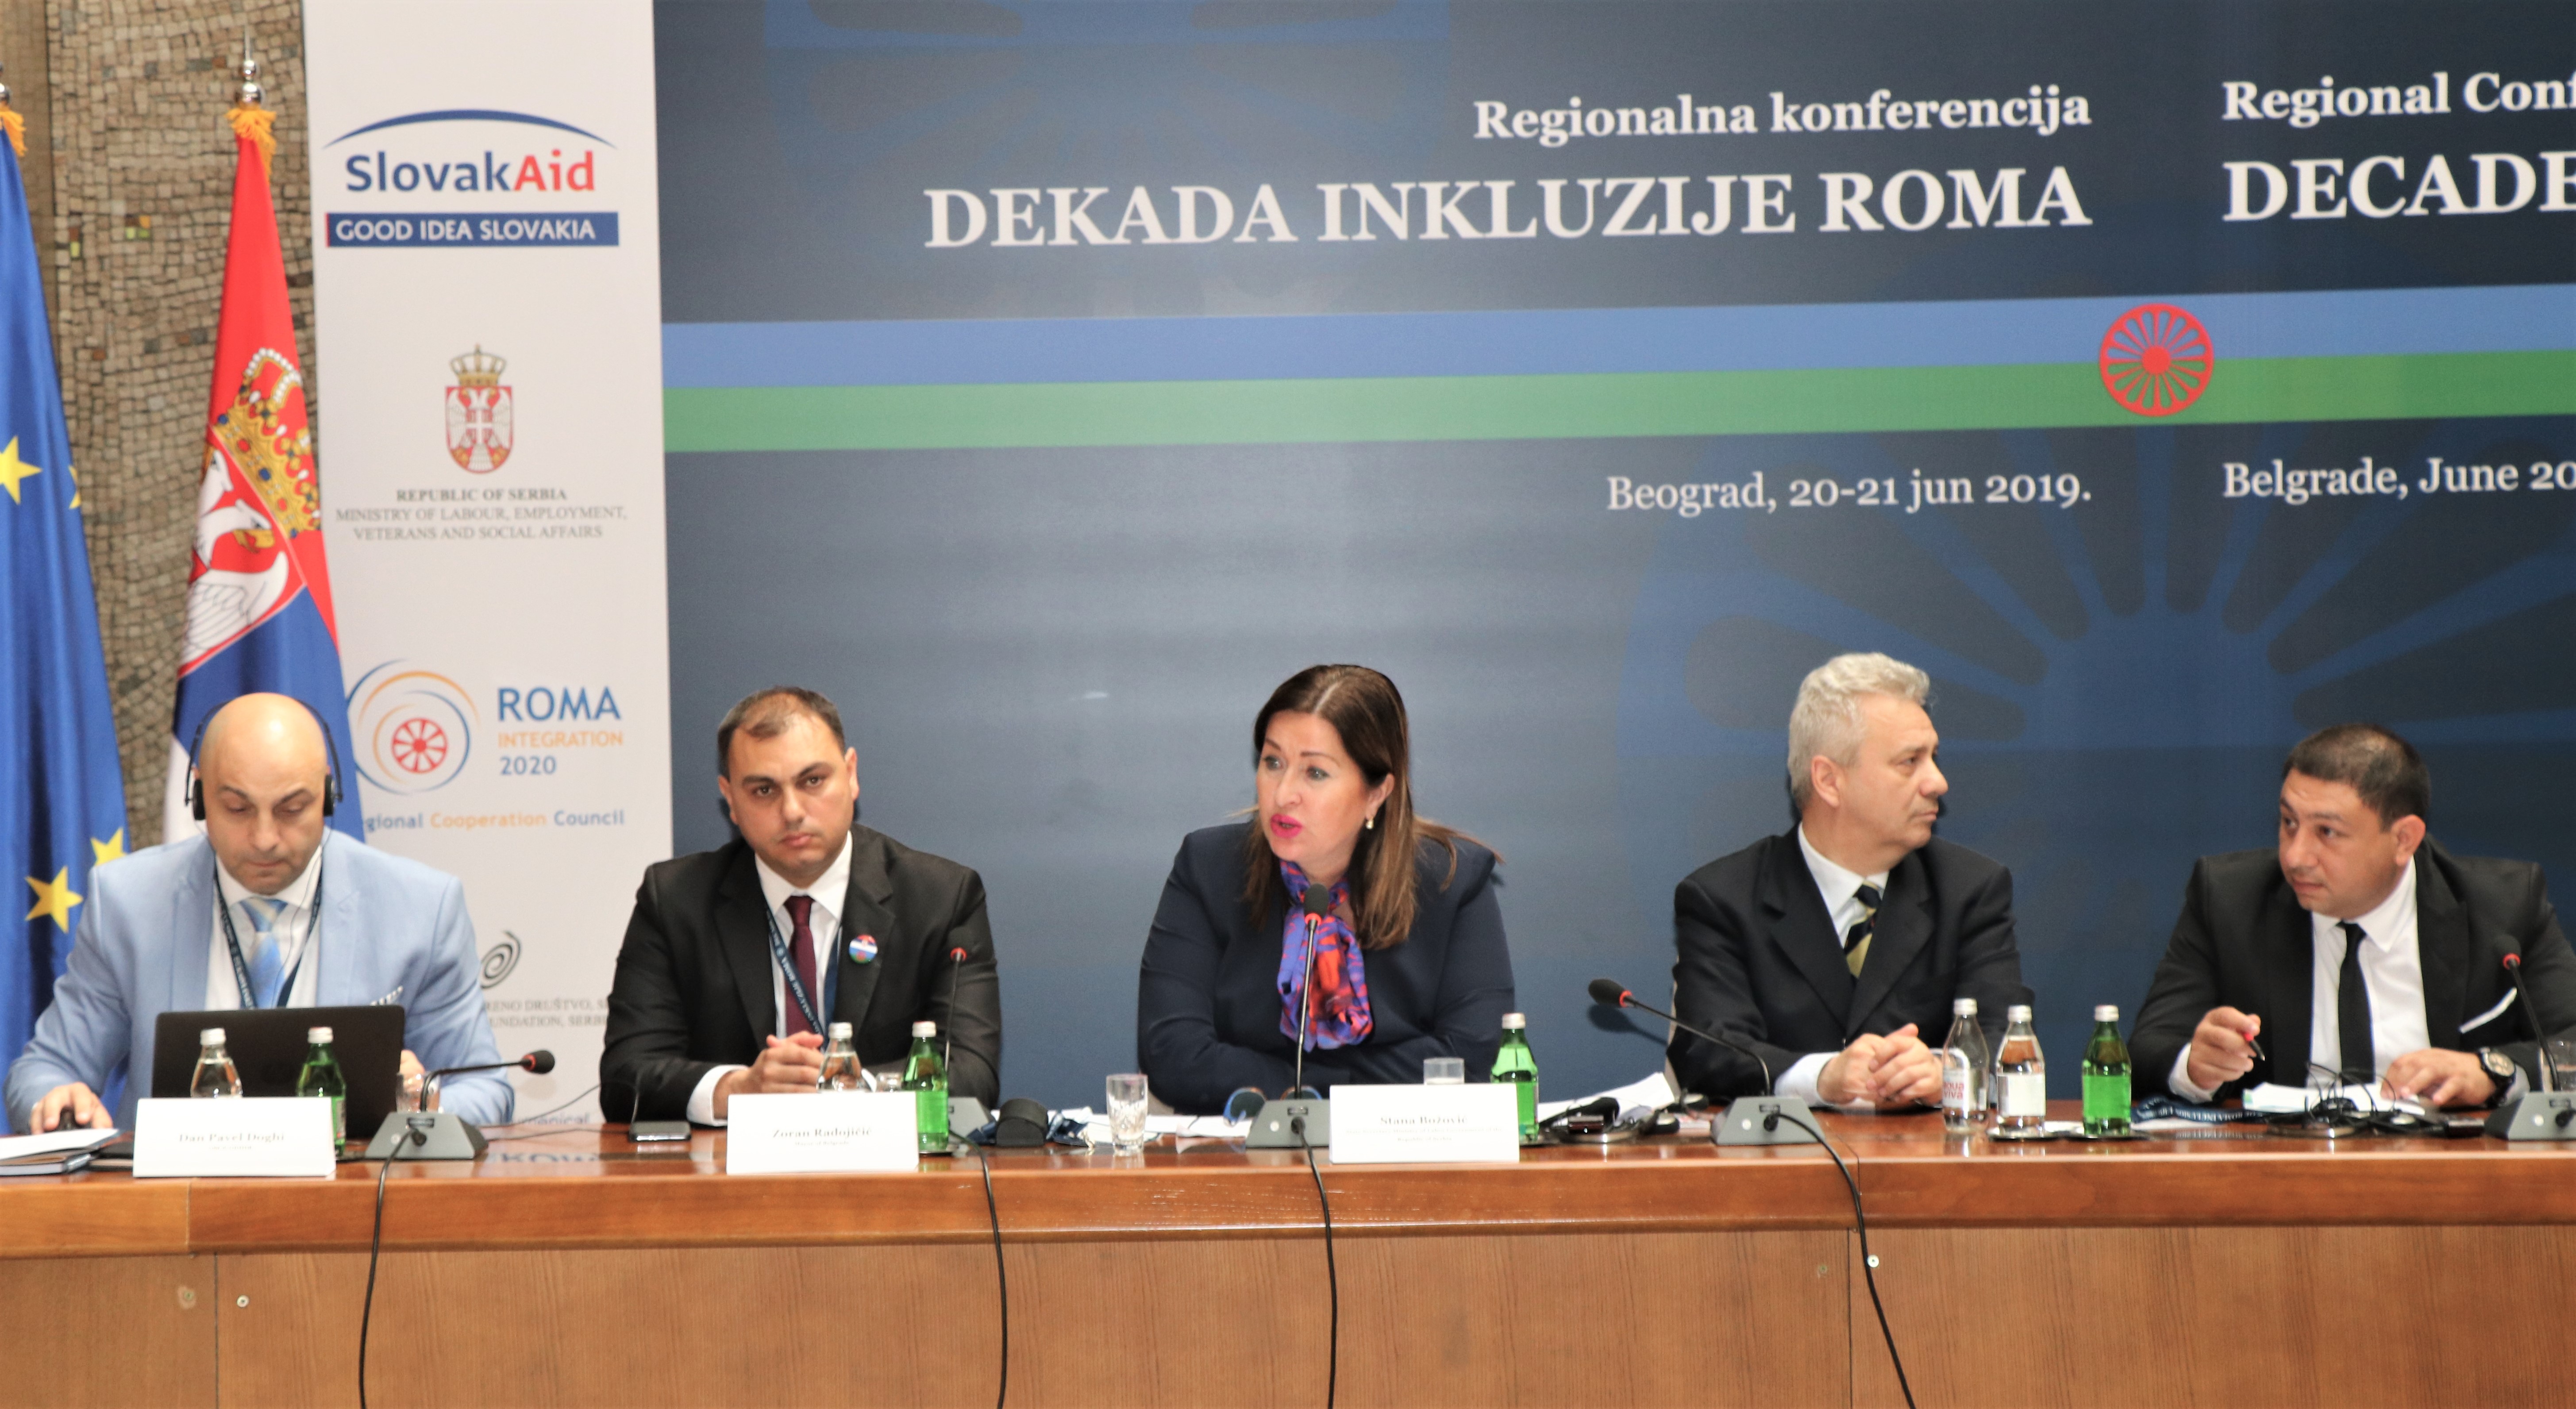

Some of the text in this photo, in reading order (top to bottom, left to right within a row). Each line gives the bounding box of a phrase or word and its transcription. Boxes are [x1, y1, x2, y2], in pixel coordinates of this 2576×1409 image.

[2222, 71, 2451, 128] Regional
[1473, 84, 2092, 148] Regionalna konferencija
[345, 149, 594, 192] SlovakAid
[2222, 150, 2576, 221] DECADE
[924, 166, 2093, 248] DEKADA INKLUZIJE ROMA
[335, 219, 596, 241] GOOD IDEA SLOVAKIA
[2223, 456, 2576, 505] Belgrade, June 20
[396, 488, 567, 502] REPUBLIC OF SERBIA
[1607, 469, 2091, 518] Beograd, 20-21 jun 2019.
[335, 505, 628, 522] MINISTRY OF LABOUR, EMPLOYMENT,
[353, 525, 603, 541] VETERANS AND SOCIAL AFFAIRS
[498, 686, 621, 722] ROMA
[498, 731, 624, 749] INTEGRATION
[500, 755, 557, 776] 2020
[365, 809, 625, 833] gional Cooperation Council
[485, 1000, 522, 1011] RENO
[489, 1016, 564, 1028] UNDATION,
[1380, 1116, 1415, 1125] Stana
[179, 1133, 204, 1142] Dan
[209, 1132, 243, 1142] Pavel
[772, 1129, 810, 1138] Zoran
